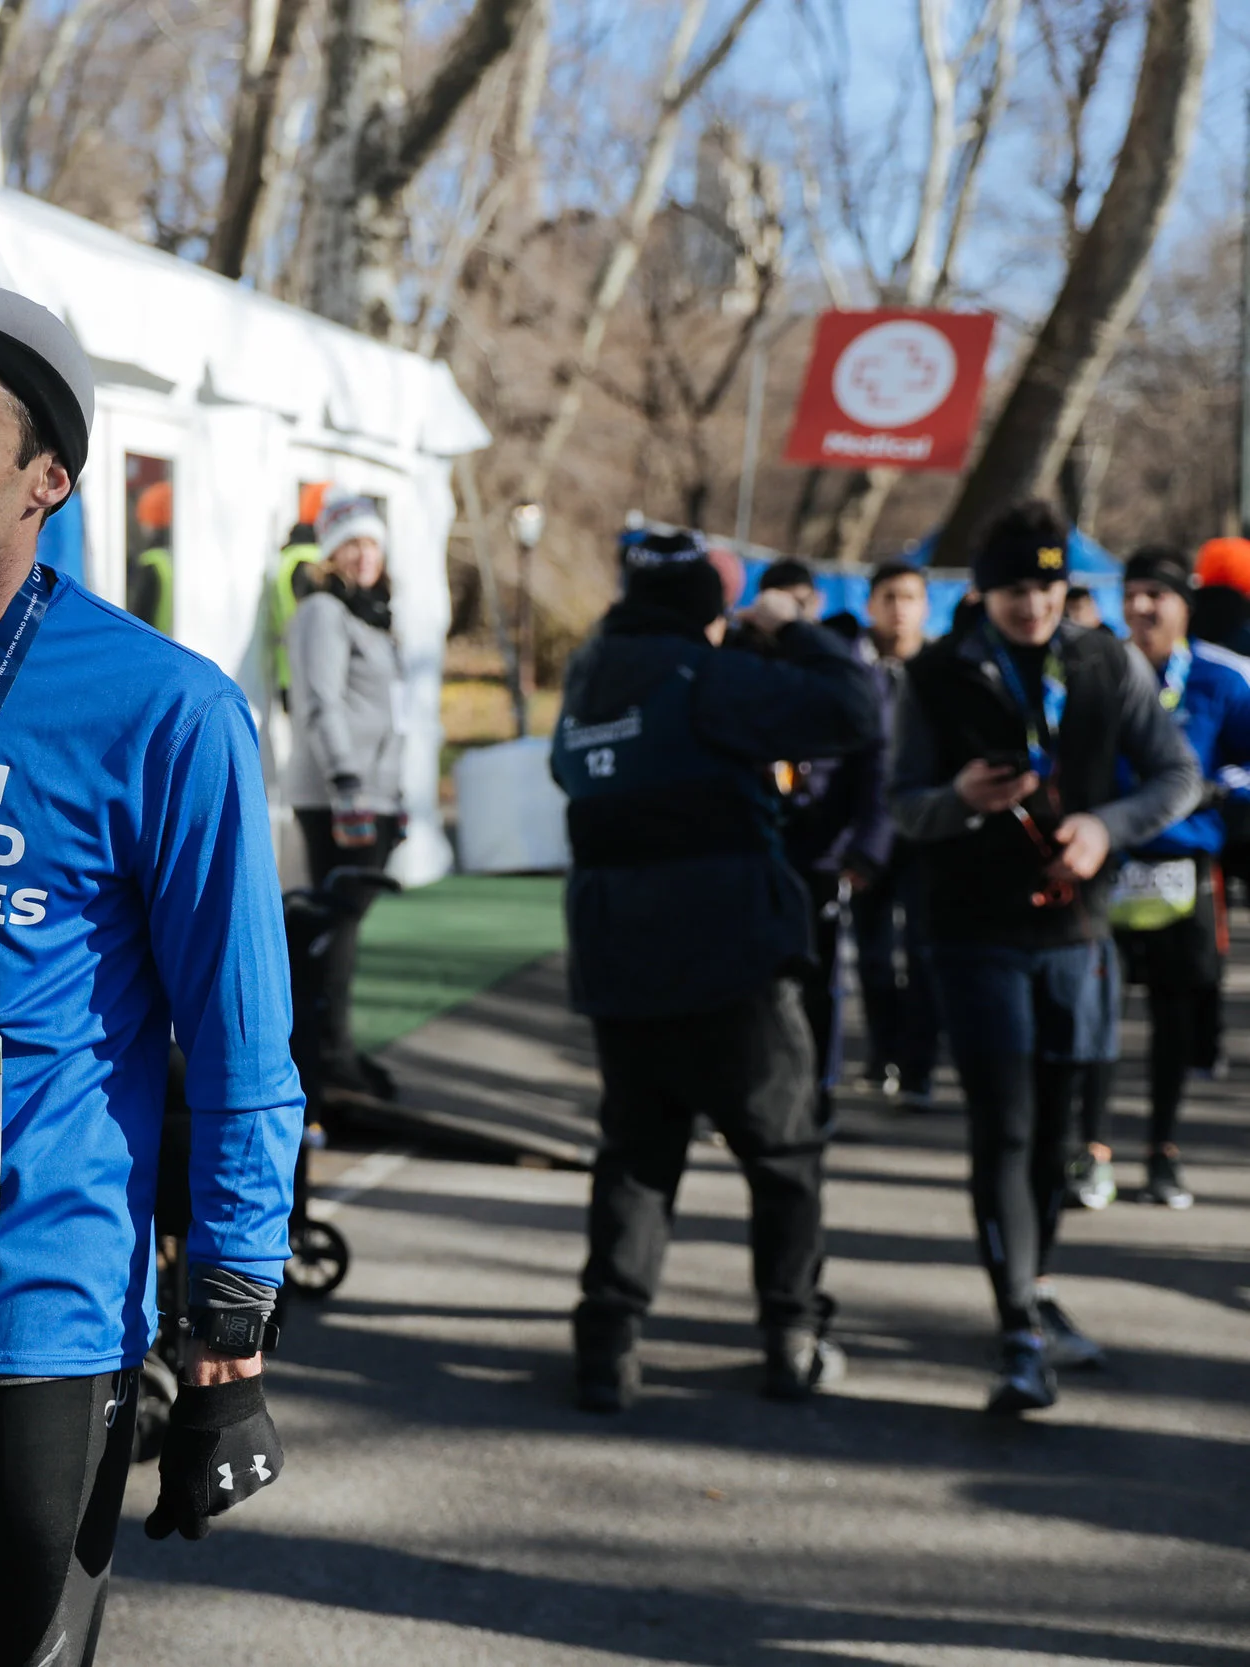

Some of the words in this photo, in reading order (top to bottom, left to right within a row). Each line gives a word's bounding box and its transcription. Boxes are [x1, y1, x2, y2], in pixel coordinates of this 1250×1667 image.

[5, 640, 17, 659] YORK
[14, 621, 27, 640] ROAD
[23, 592, 38, 621] RUNNERS
